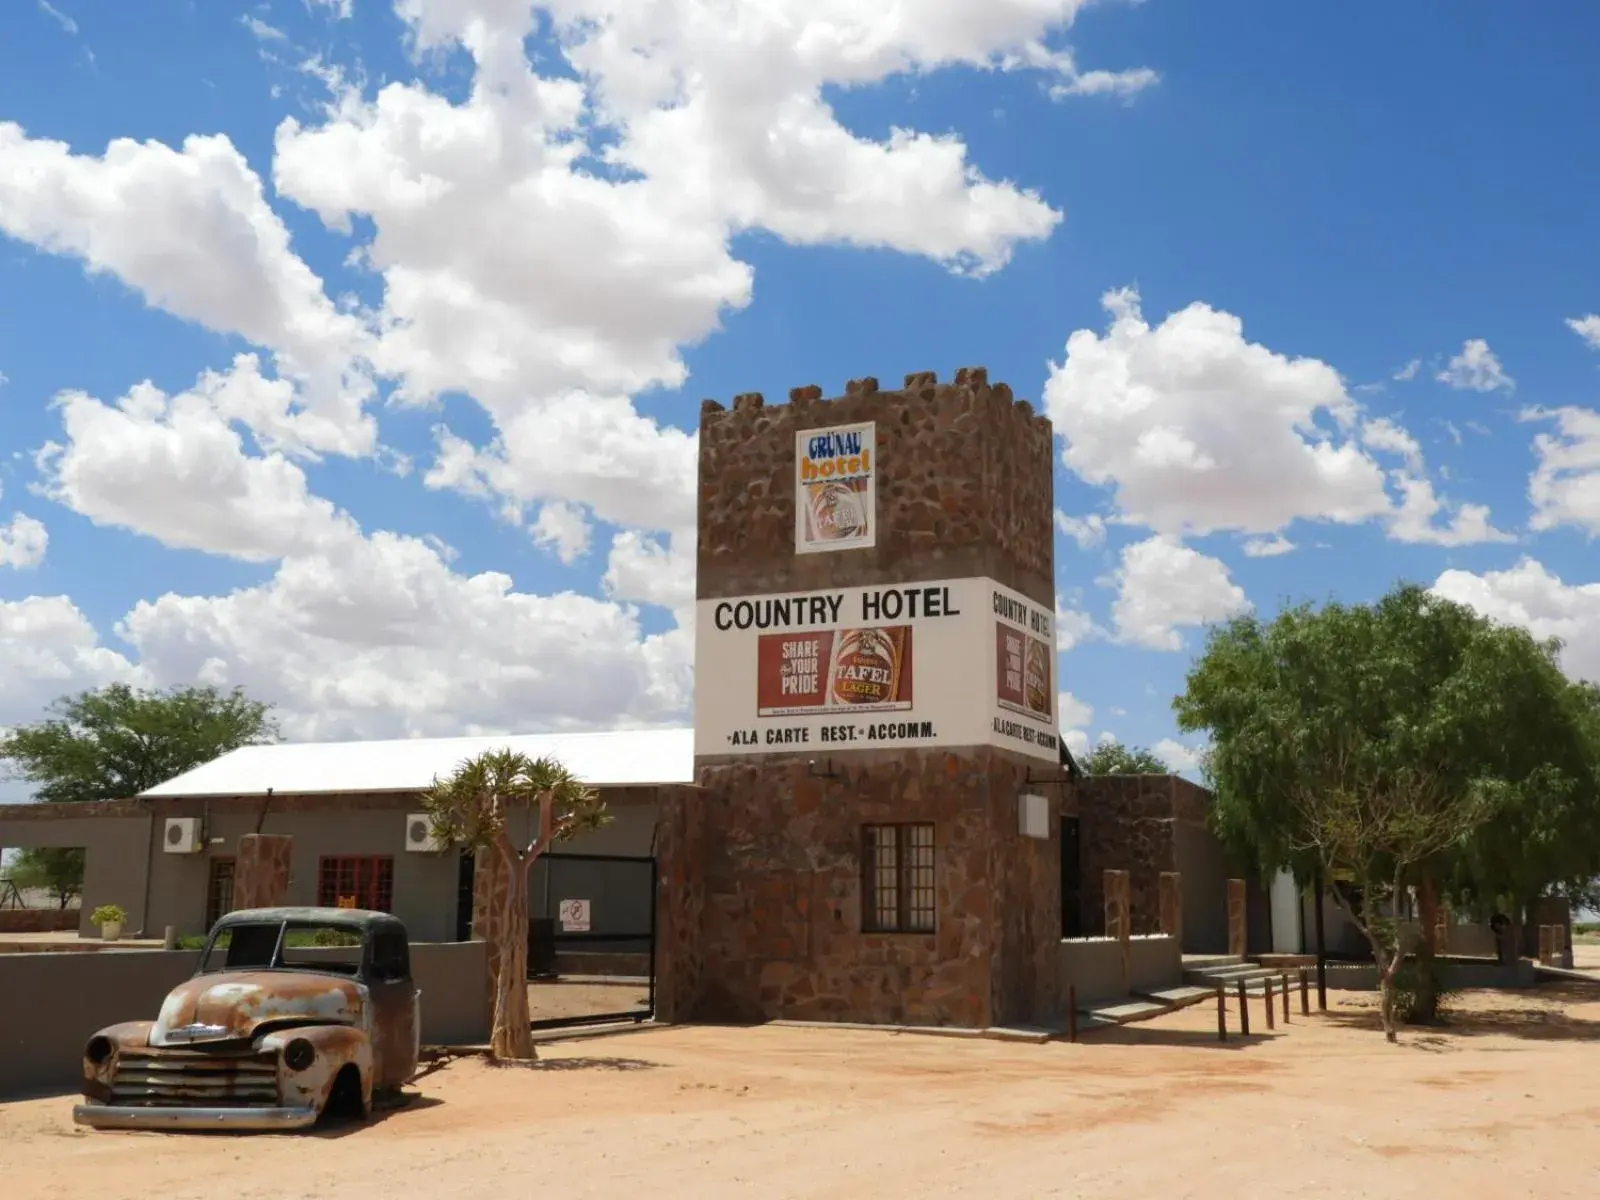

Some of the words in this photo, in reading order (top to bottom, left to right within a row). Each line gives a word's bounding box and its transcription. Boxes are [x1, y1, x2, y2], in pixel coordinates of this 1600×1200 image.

[809, 431, 862, 460] GRÜNAU
[801, 448, 870, 480] hotel
[714, 594, 844, 631] COUNTRY
[862, 587, 960, 620] HOTEL
[993, 590, 1027, 626] COUNTRY
[782, 640, 819, 659] SHARE
[791, 658, 818, 675] YOUR
[837, 665, 892, 686] TAFEL
[782, 674, 819, 695] PRIDE
[842, 681, 881, 697] LAGER
[766, 727, 809, 744] CARTE
[868, 721, 937, 740] ACCOMM.
